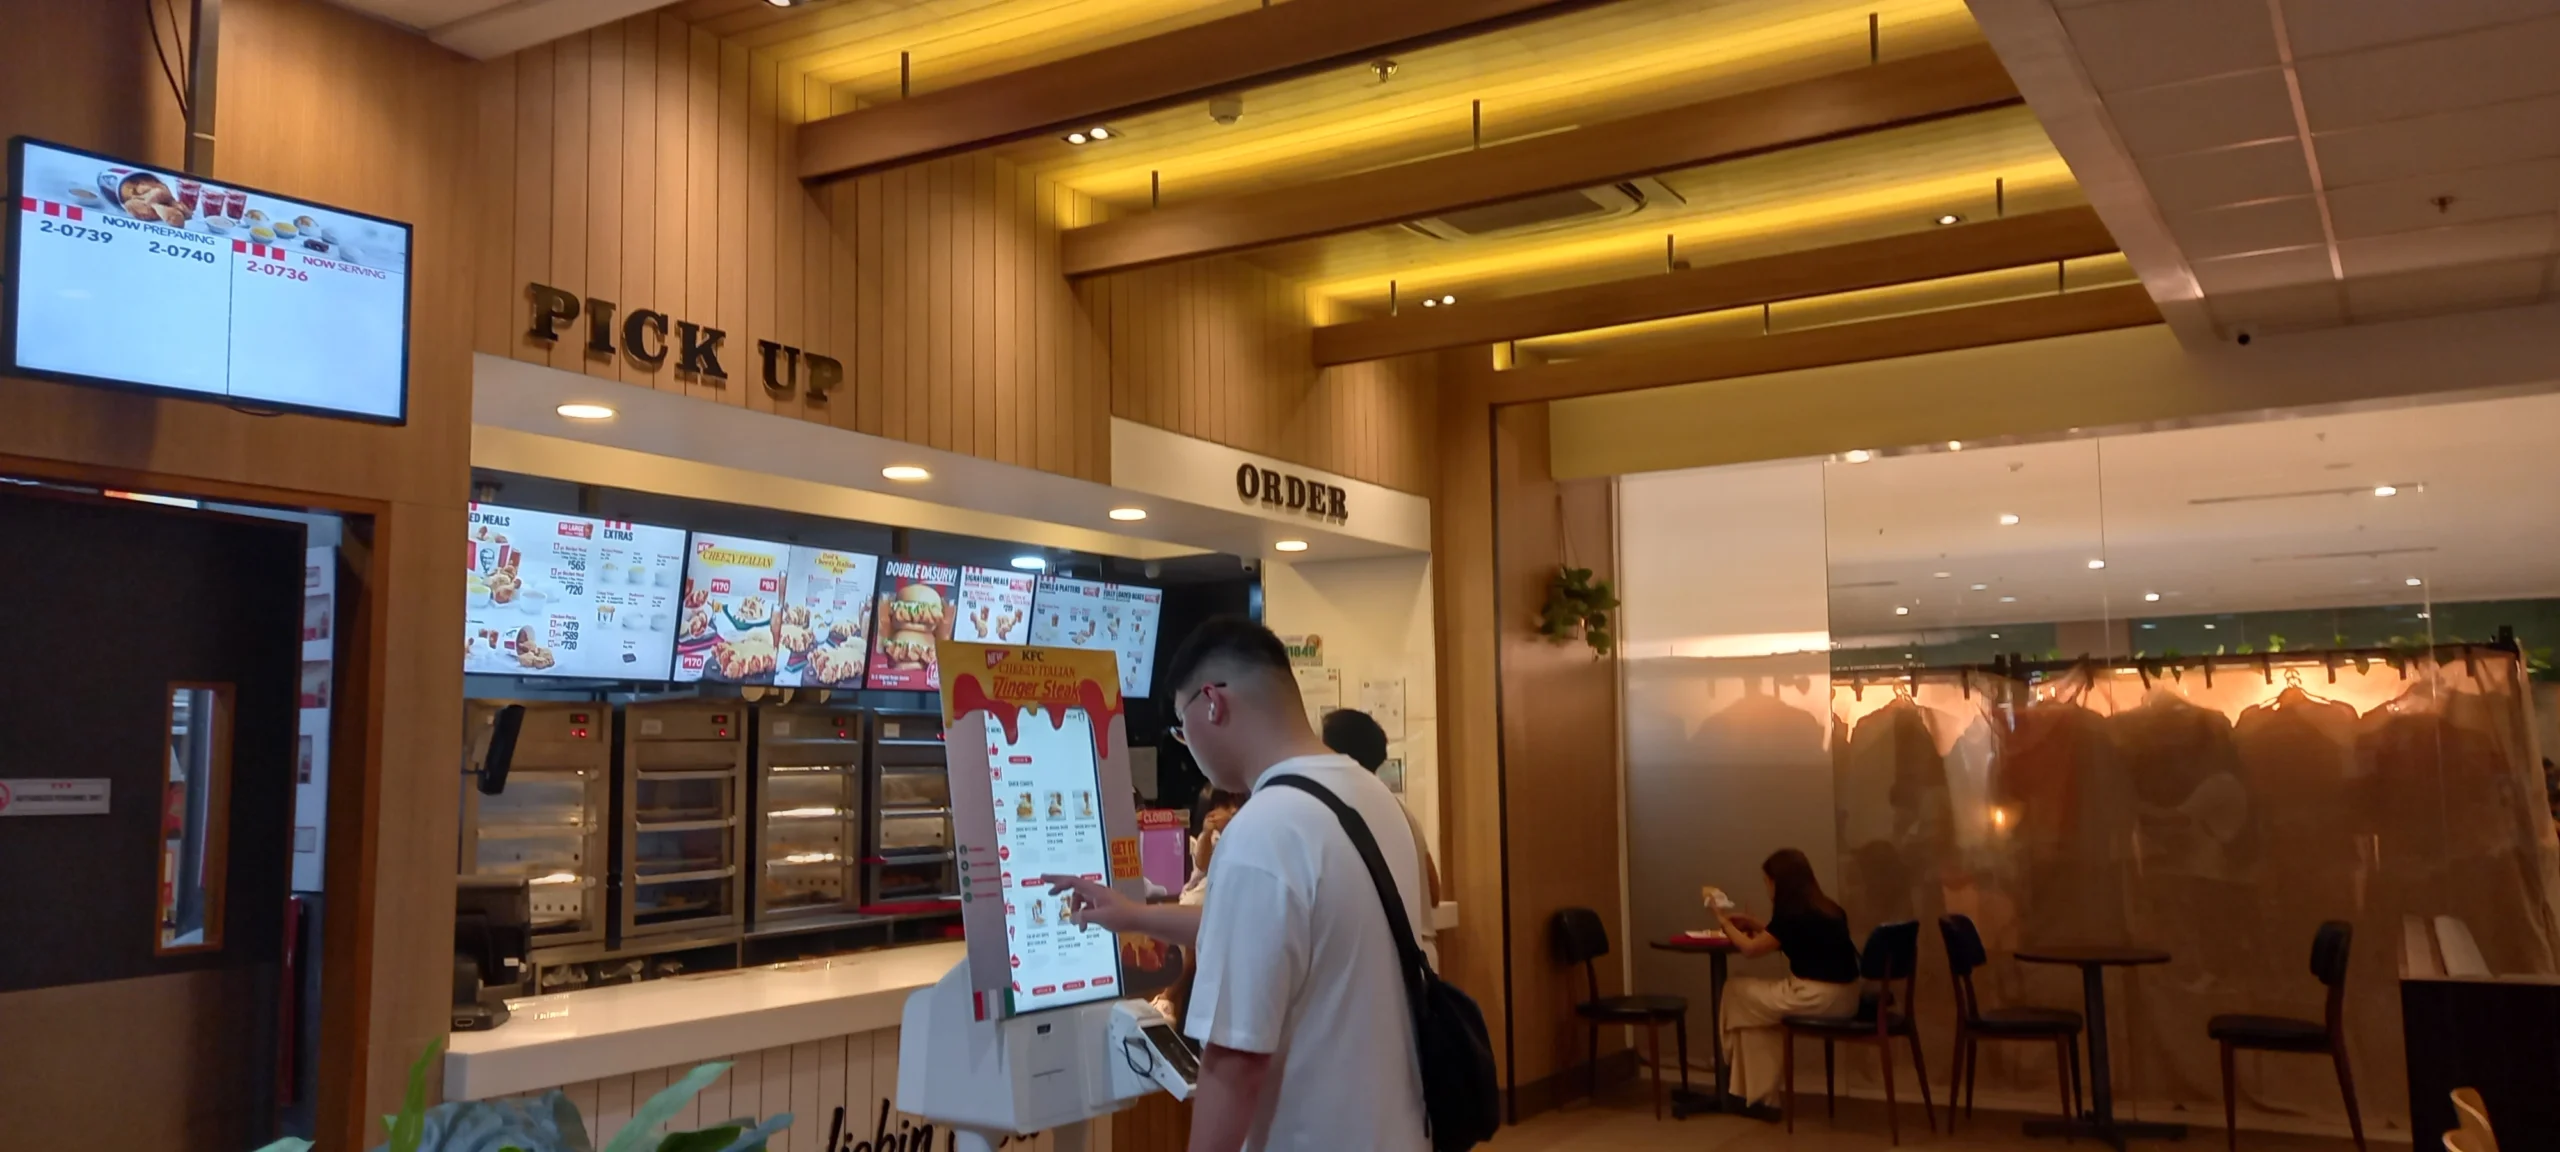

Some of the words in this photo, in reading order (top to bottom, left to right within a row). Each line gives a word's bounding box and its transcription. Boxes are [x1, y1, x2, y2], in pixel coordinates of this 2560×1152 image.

[40, 219, 113, 244] 2-0739
[103, 215, 141, 232] NOW
[143, 223, 215, 246] PREPARING
[149, 241, 216, 264] 2-0740
[246, 260, 309, 282] 2-0736
[303, 255, 336, 270] NOW
[337, 262, 386, 280] SERVING
[529, 281, 728, 381] PICK
[758, 338, 844, 404] UP
[1236, 462, 1348, 520] ORDER
[482, 513, 510, 527] MEALS
[603, 529, 634, 541] EXTRAS
[736, 554, 774, 569] ITALIAN
[885, 561, 921, 580] DOUBLE
[987, 652, 1004, 664] NEW
[1021, 649, 1044, 662] KFC
[999, 663, 1038, 676] CHEEZY
[1038, 664, 1076, 678] ITALIAN
[993, 676, 1038, 700] Zinger
[1042, 679, 1081, 701] Steak
